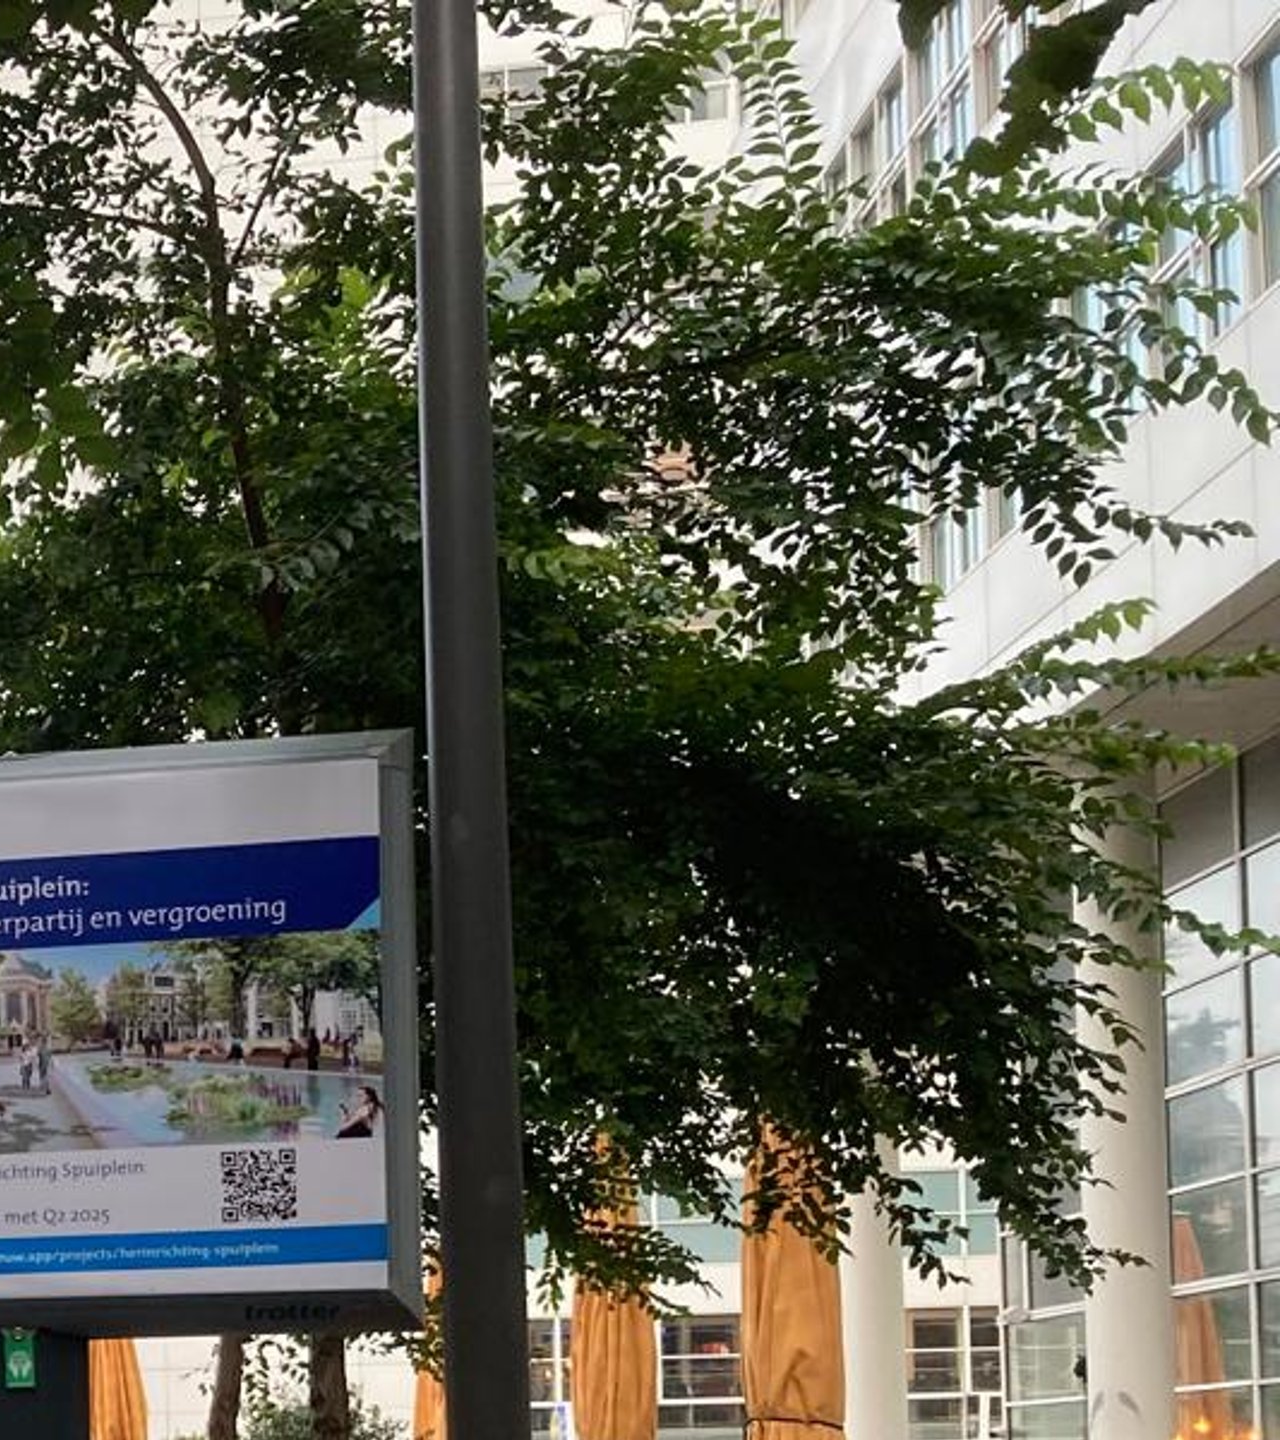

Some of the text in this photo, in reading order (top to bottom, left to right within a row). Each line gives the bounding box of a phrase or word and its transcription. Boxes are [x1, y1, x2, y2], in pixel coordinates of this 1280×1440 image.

[91, 911, 122, 929] en
[128, 898, 287, 932] vergroening
[62, 1159, 146, 1179] Spuiplein
[5, 1209, 39, 1225] met
[42, 1208, 66, 1226] Q2
[70, 1207, 111, 1225] 2025
[244, 1305, 340, 1321] trotter
